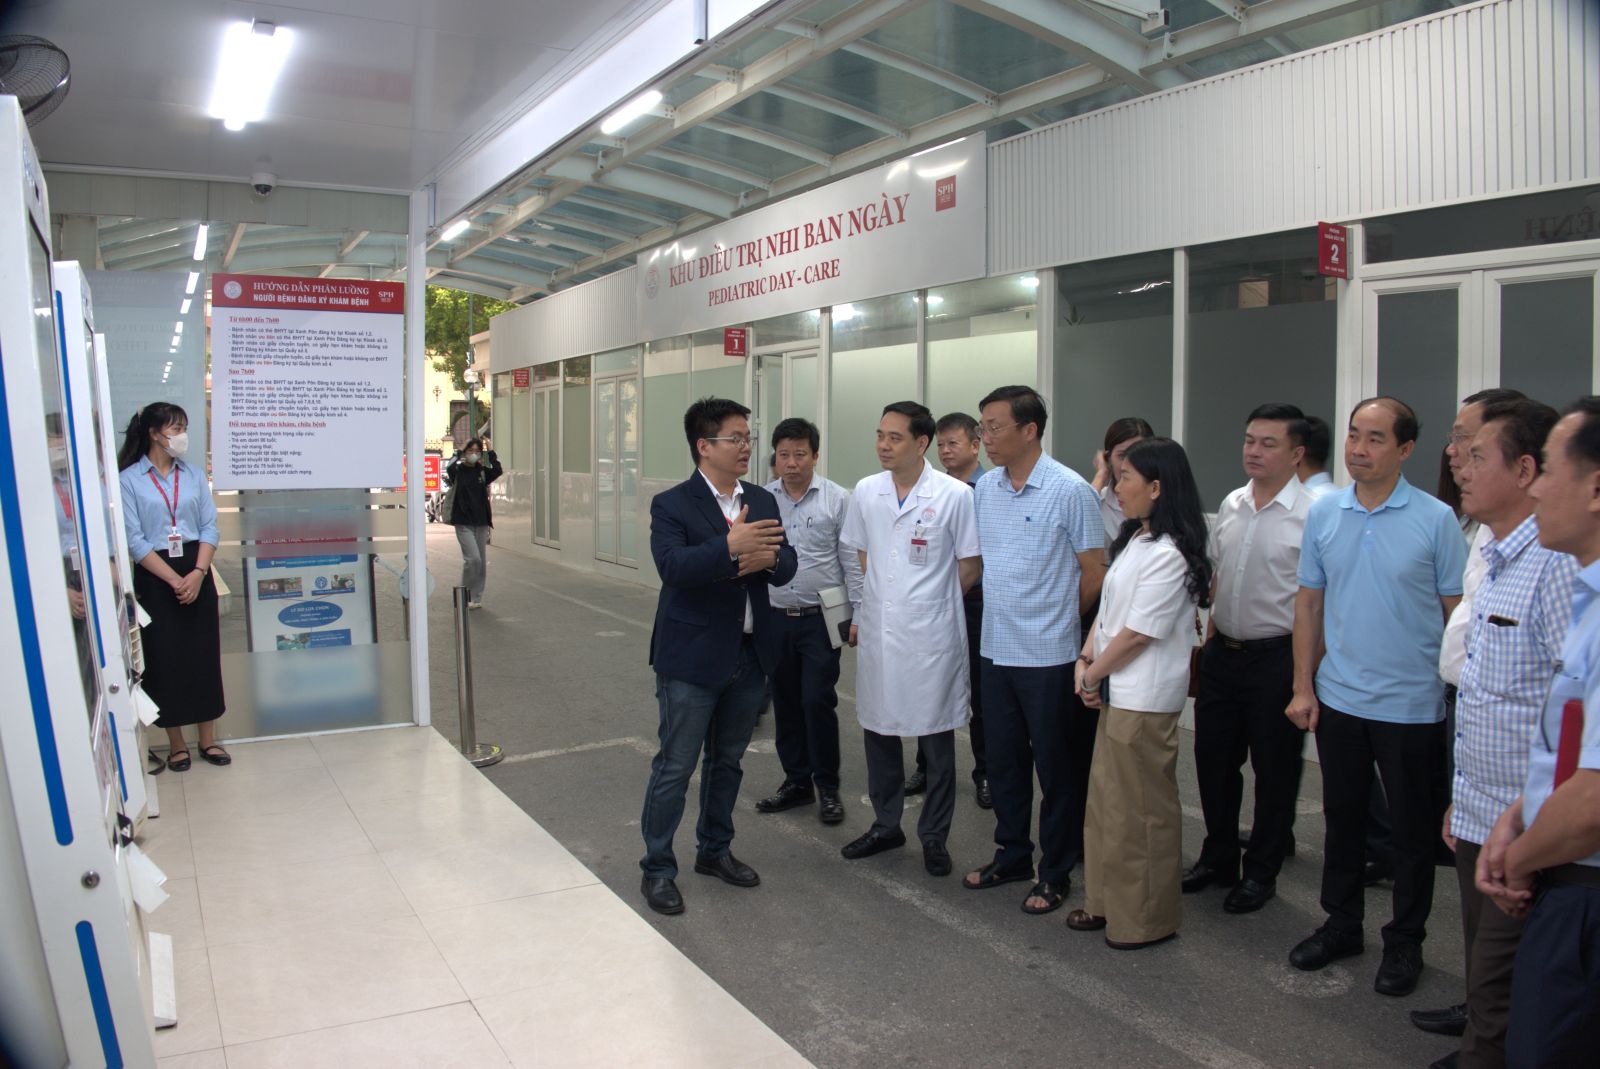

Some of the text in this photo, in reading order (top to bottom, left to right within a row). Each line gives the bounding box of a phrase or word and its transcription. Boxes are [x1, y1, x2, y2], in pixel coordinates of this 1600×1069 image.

[938, 184, 954, 196] SPH
[668, 192, 910, 288] KHU ĐIỀU TRỊ NHI BAN NGÀY
[1331, 243, 1339, 263] 2
[254, 281, 369, 295] HƯỚNG DẪN PHÂN LUỒNG
[708, 278, 767, 307] PEDIATRIC
[253, 294, 275, 302] NGƯỜI
[277, 294, 296, 303] BỆNH
[298, 295, 317, 304] ĐĂNG
[319, 296, 328, 304] KÝ
[329, 296, 349, 305] KHÁM
[351, 297, 369, 306] BỆNH
[734, 339, 739, 349] 1
